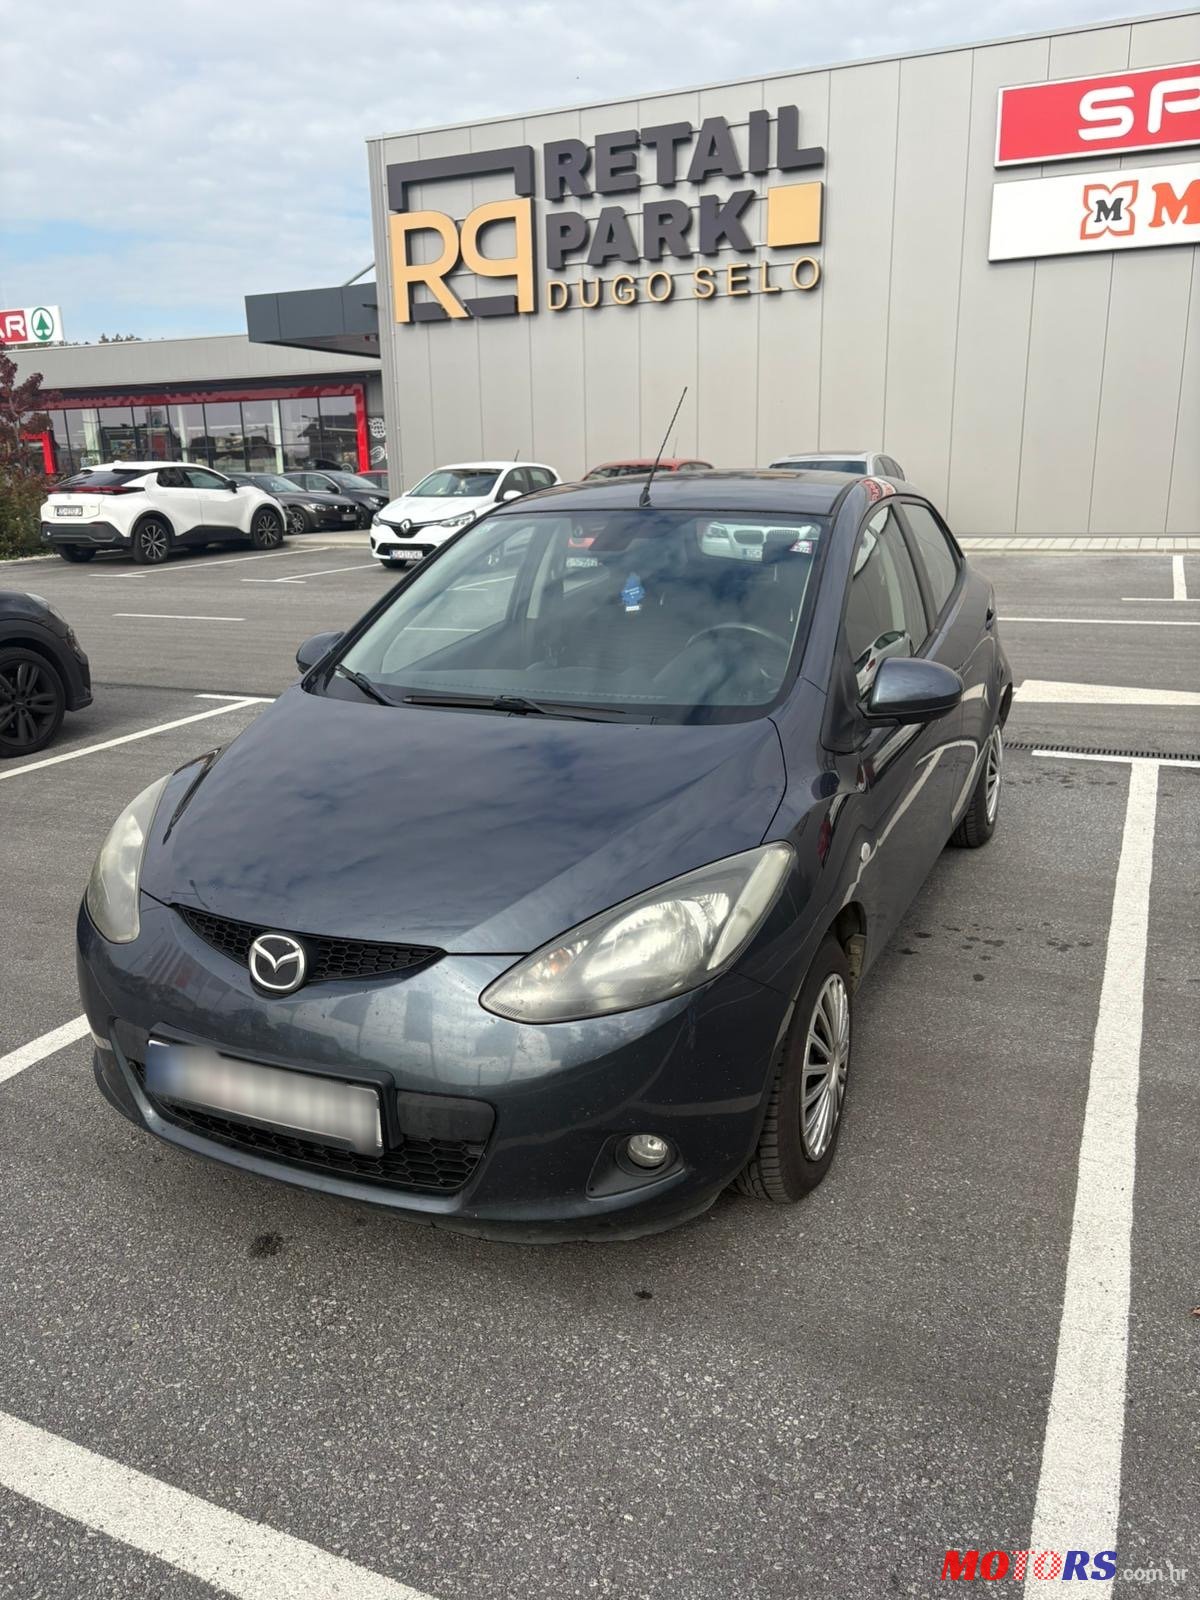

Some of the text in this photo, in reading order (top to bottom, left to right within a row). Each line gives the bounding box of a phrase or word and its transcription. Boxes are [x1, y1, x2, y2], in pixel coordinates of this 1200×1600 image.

[543, 104, 825, 201] RETAIL
[545, 189, 757, 270] PARK
[1094, 197, 1124, 223] M
[547, 256, 823, 311] DUGO SELO
[0, 314, 26, 339] R
